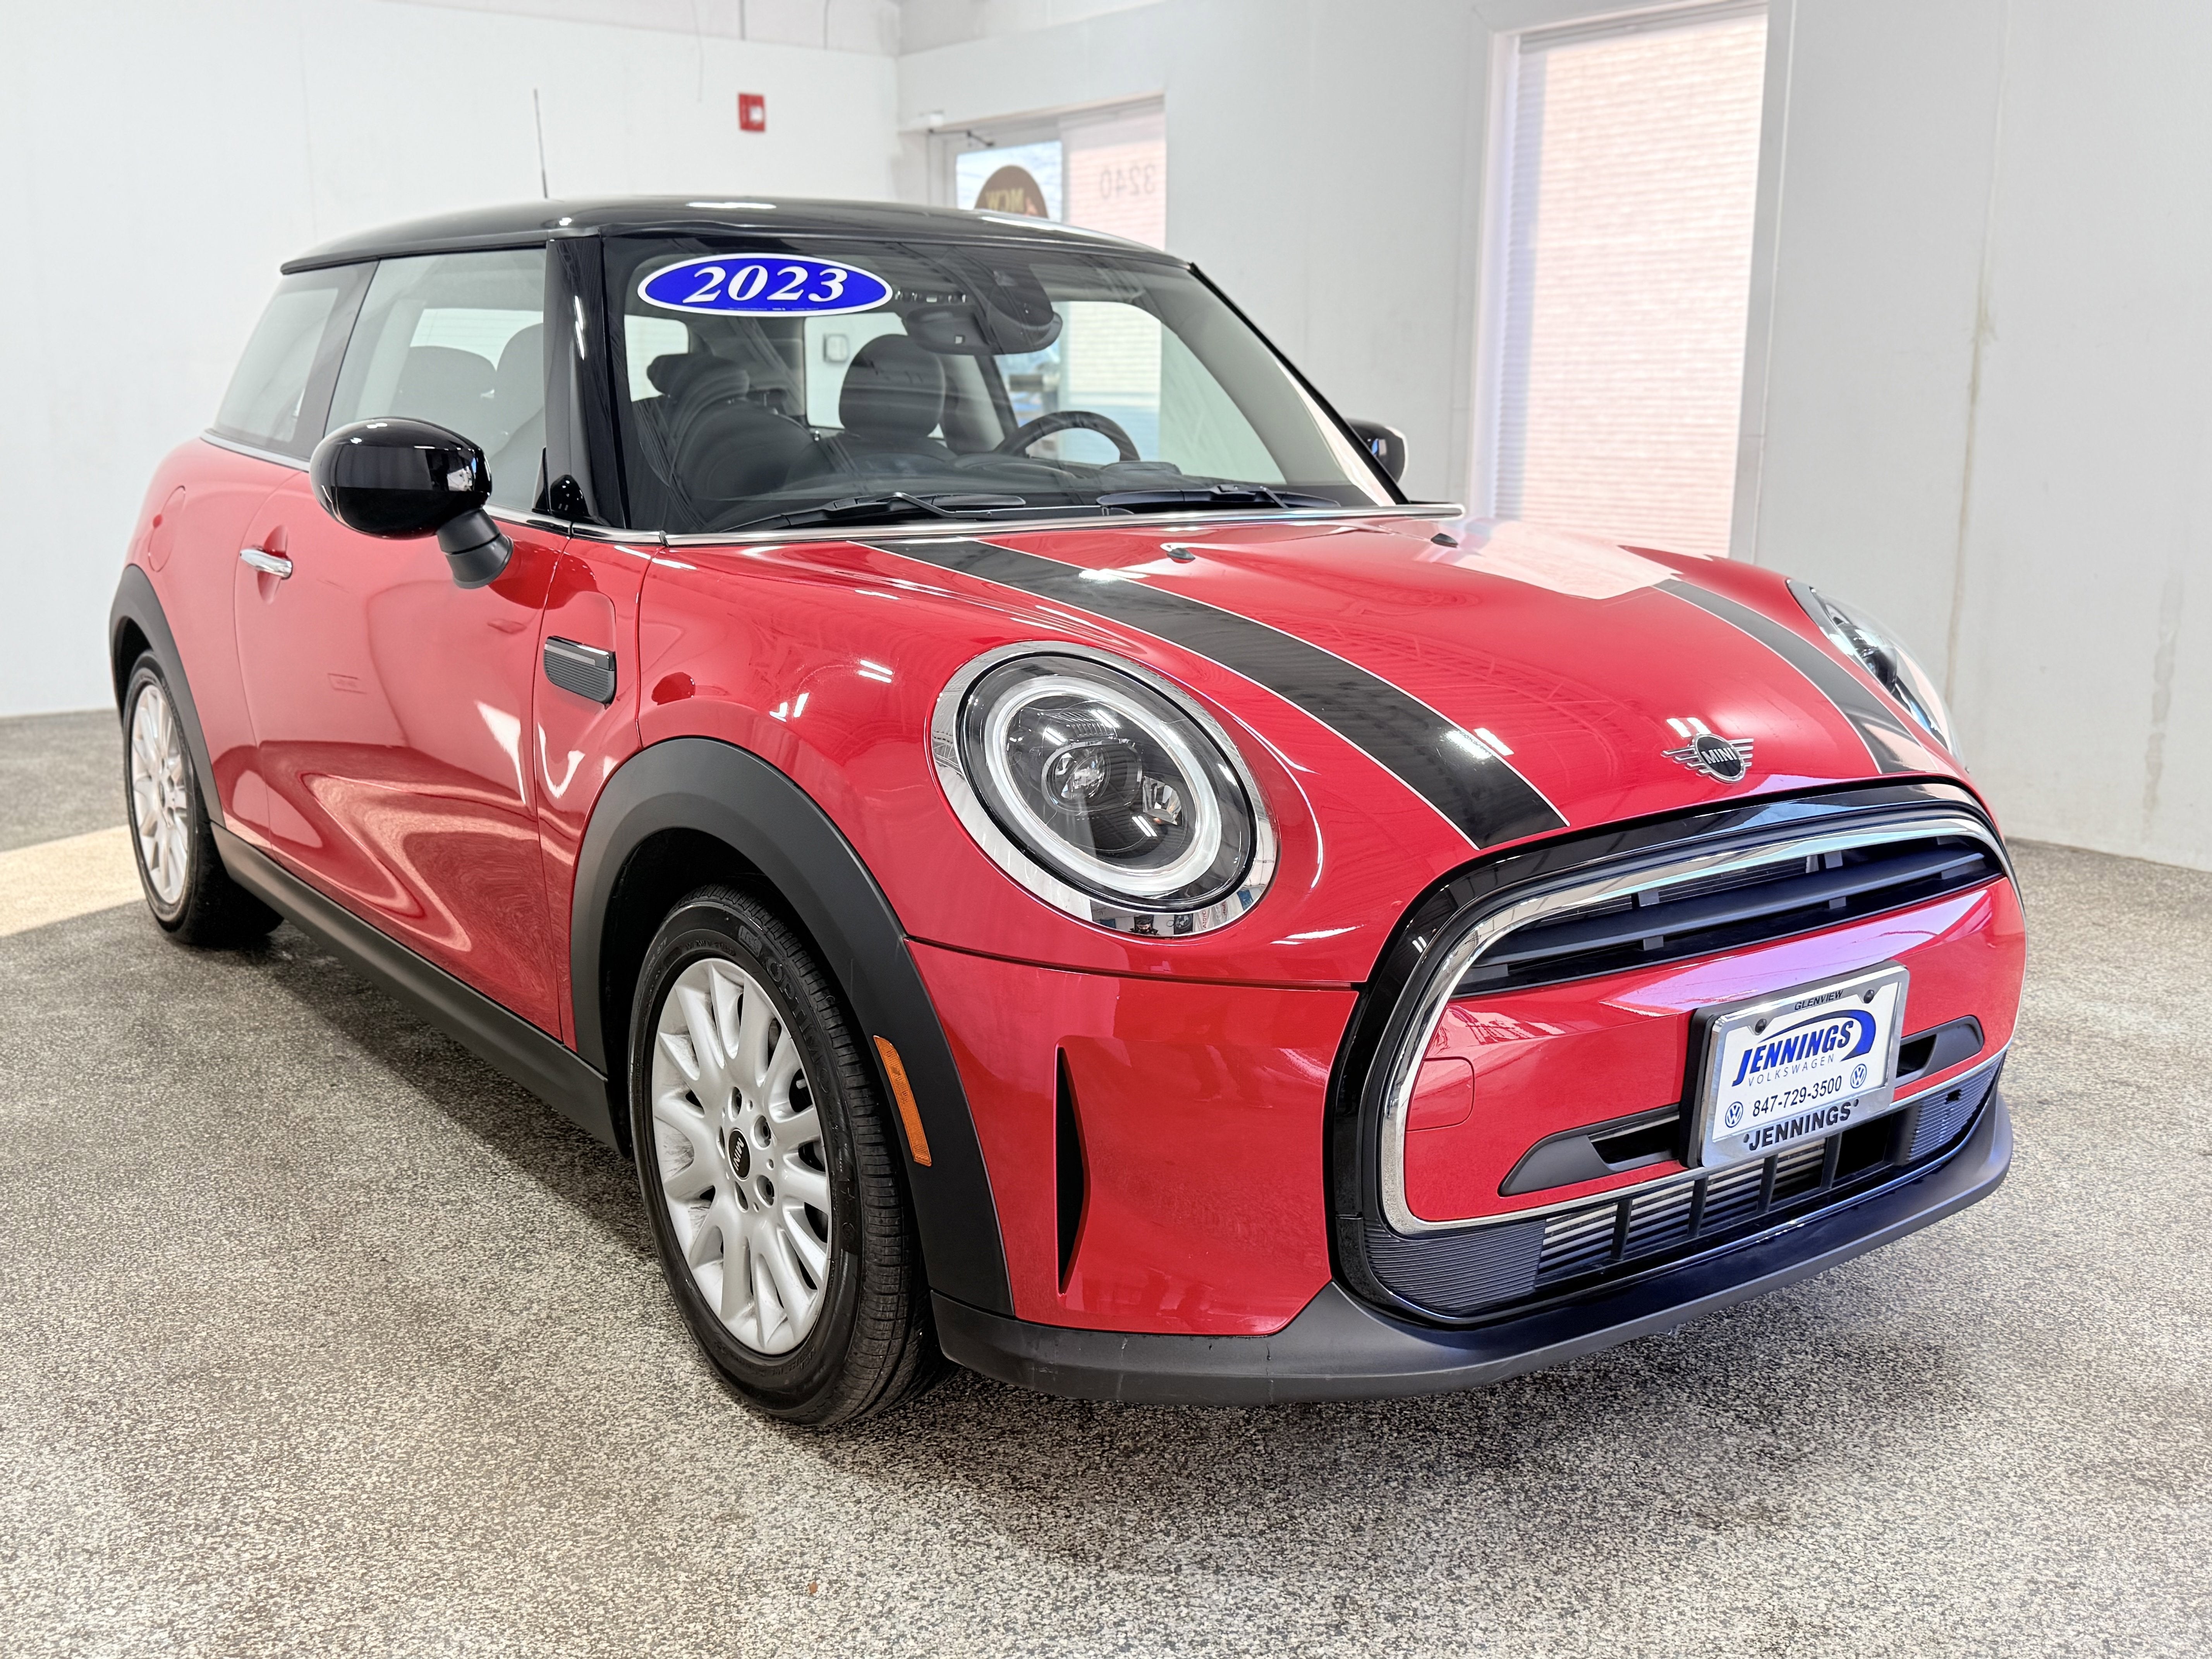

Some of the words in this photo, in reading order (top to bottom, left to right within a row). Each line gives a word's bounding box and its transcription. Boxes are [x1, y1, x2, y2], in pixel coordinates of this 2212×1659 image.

[682, 265, 848, 304] 2023
[1701, 747, 1737, 764] MINI
[1794, 990, 1843, 1011] GLENVIEW
[1731, 1020, 1854, 1087] JENNINGS
[1748, 1054, 1834, 1086] VOLKSWAGEN
[1752, 1075, 1842, 1117] 847-729-3500
[1748, 1102, 1851, 1151] JENNINGS
[733, 1137, 744, 1171] MINI
